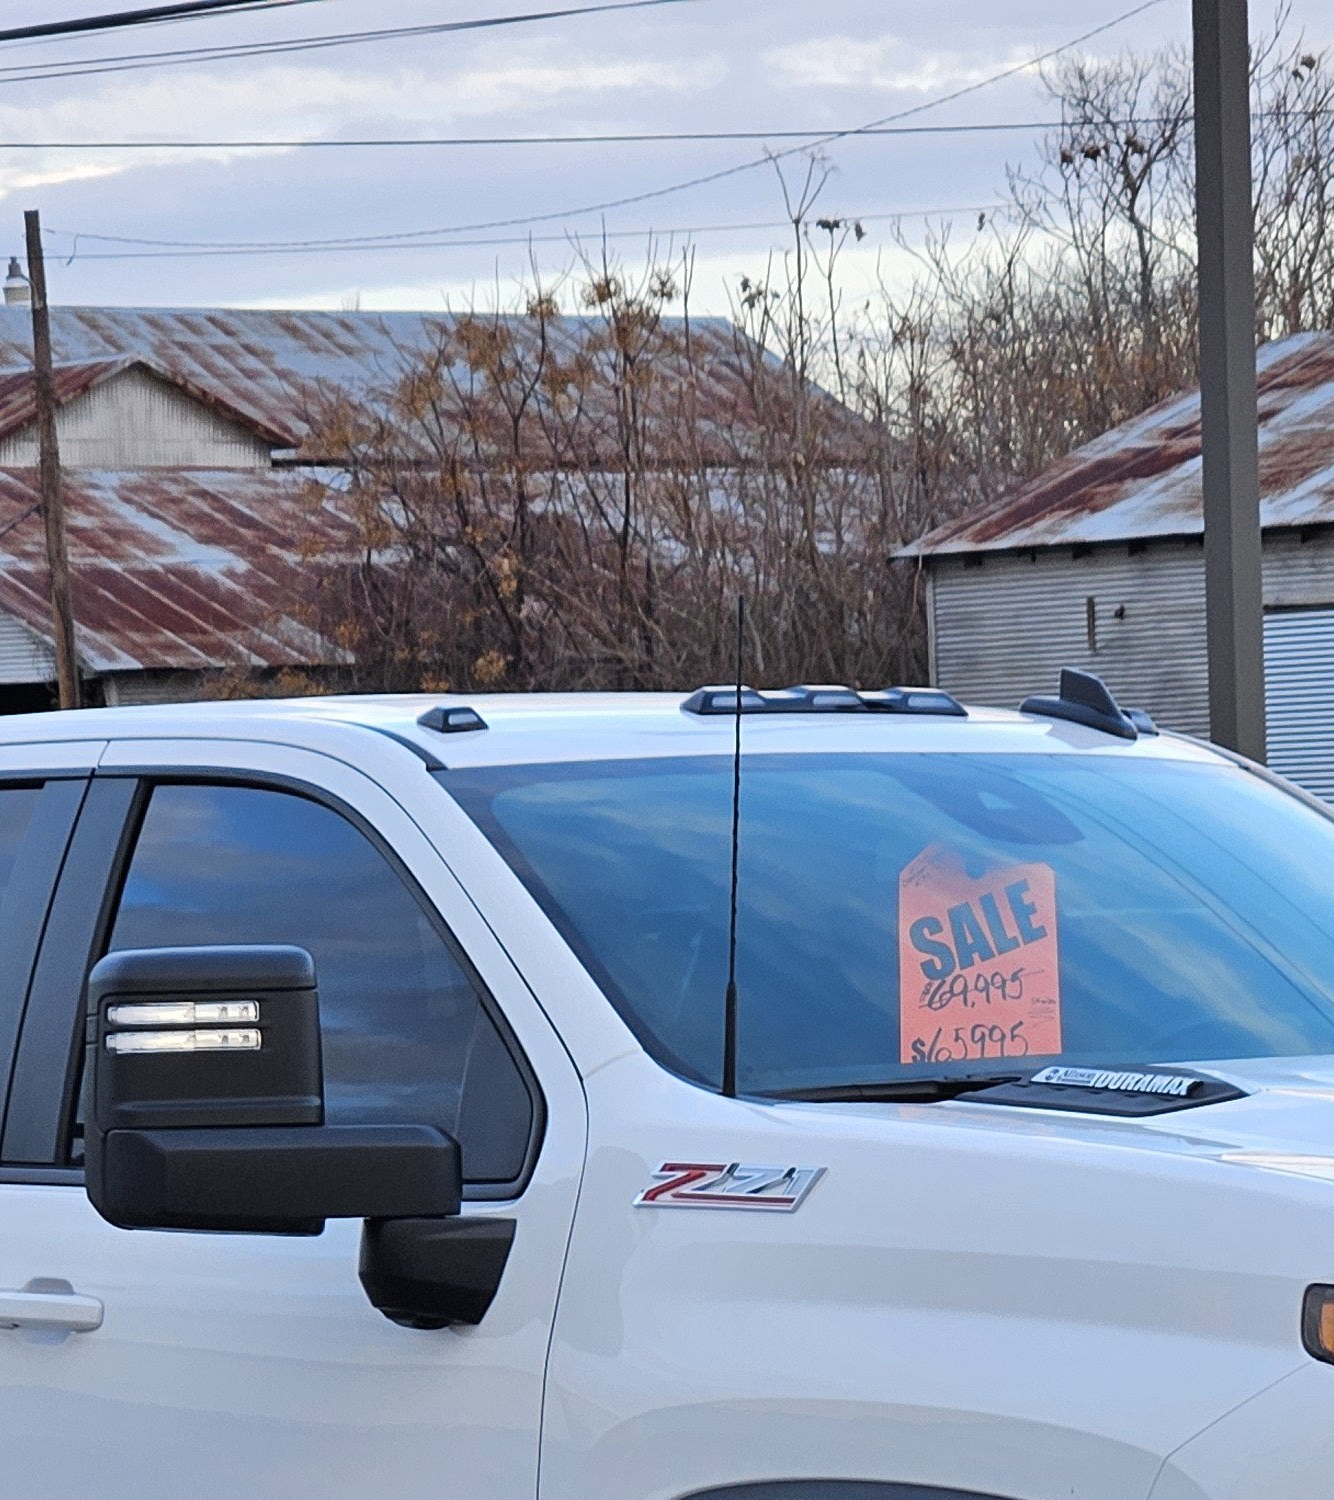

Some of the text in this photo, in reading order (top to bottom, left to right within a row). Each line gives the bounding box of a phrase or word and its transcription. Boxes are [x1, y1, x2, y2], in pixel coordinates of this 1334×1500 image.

[908, 878, 1048, 981] SALE
[1095, 1072, 1200, 1096] DURAMAX
[632, 1162, 827, 1213] Z71
